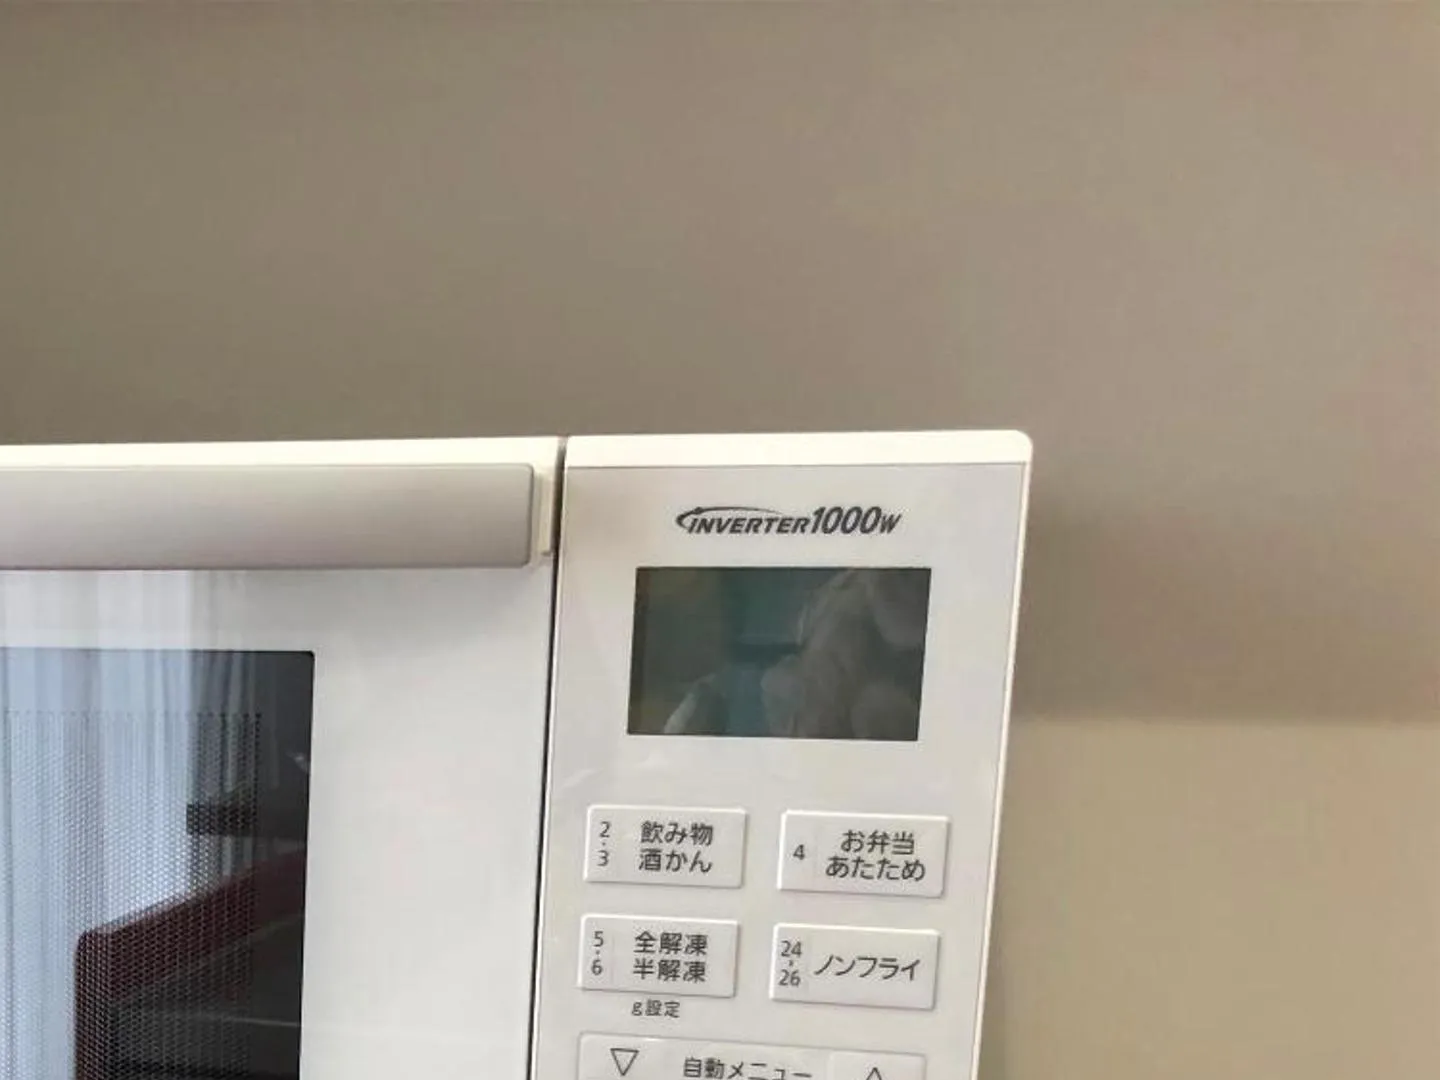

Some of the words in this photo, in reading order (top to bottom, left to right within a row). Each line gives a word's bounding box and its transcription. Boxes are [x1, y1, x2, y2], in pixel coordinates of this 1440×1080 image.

[640, 821, 714, 847] 飲み物
[840, 829, 915, 856] お弁当
[638, 849, 713, 875] 酒かん
[792, 844, 806, 861] 4
[825, 857, 926, 882] あたため
[633, 931, 708, 957] 全解凍
[632, 959, 706, 984] 半解凍
[814, 954, 921, 982] ノンフライ
